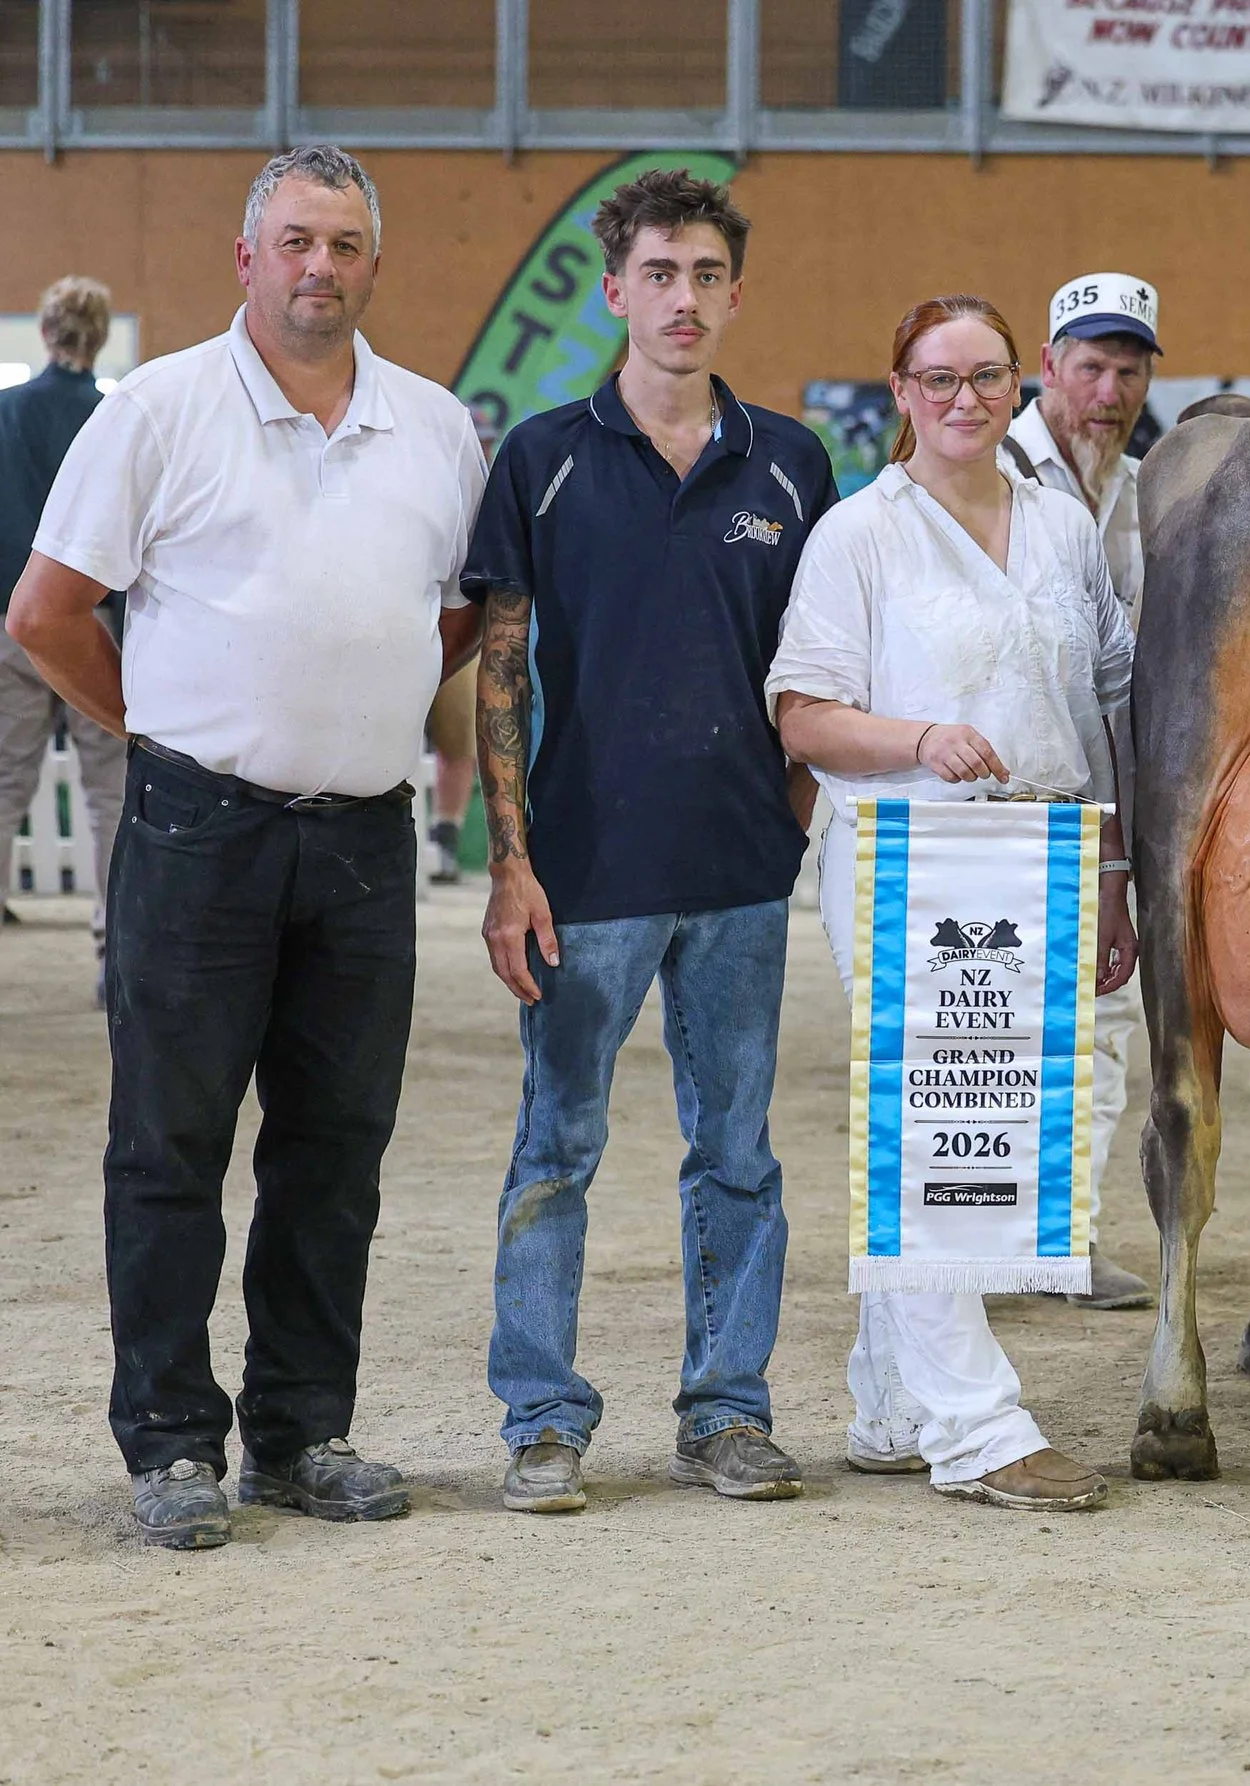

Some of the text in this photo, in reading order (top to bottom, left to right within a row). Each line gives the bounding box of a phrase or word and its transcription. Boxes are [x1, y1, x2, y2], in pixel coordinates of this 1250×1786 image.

[1088, 19, 1160, 43] NOW
[1056, 285, 1098, 320] 335
[1119, 294, 1156, 322] SEME
[969, 927, 984, 936] NZ
[942, 949, 1011, 961] DAIRYEVENT
[960, 969, 992, 986] NZ
[939, 990, 1013, 1008] DAIRY
[935, 1011, 1015, 1029] EVENT
[932, 1049, 1015, 1065] GRAND
[909, 1069, 1039, 1087] CHAMPION
[909, 1091, 1037, 1109] COMBINED
[932, 1131, 1012, 1158] 2026
[926, 1192, 1016, 1205] PGG Wrightson
